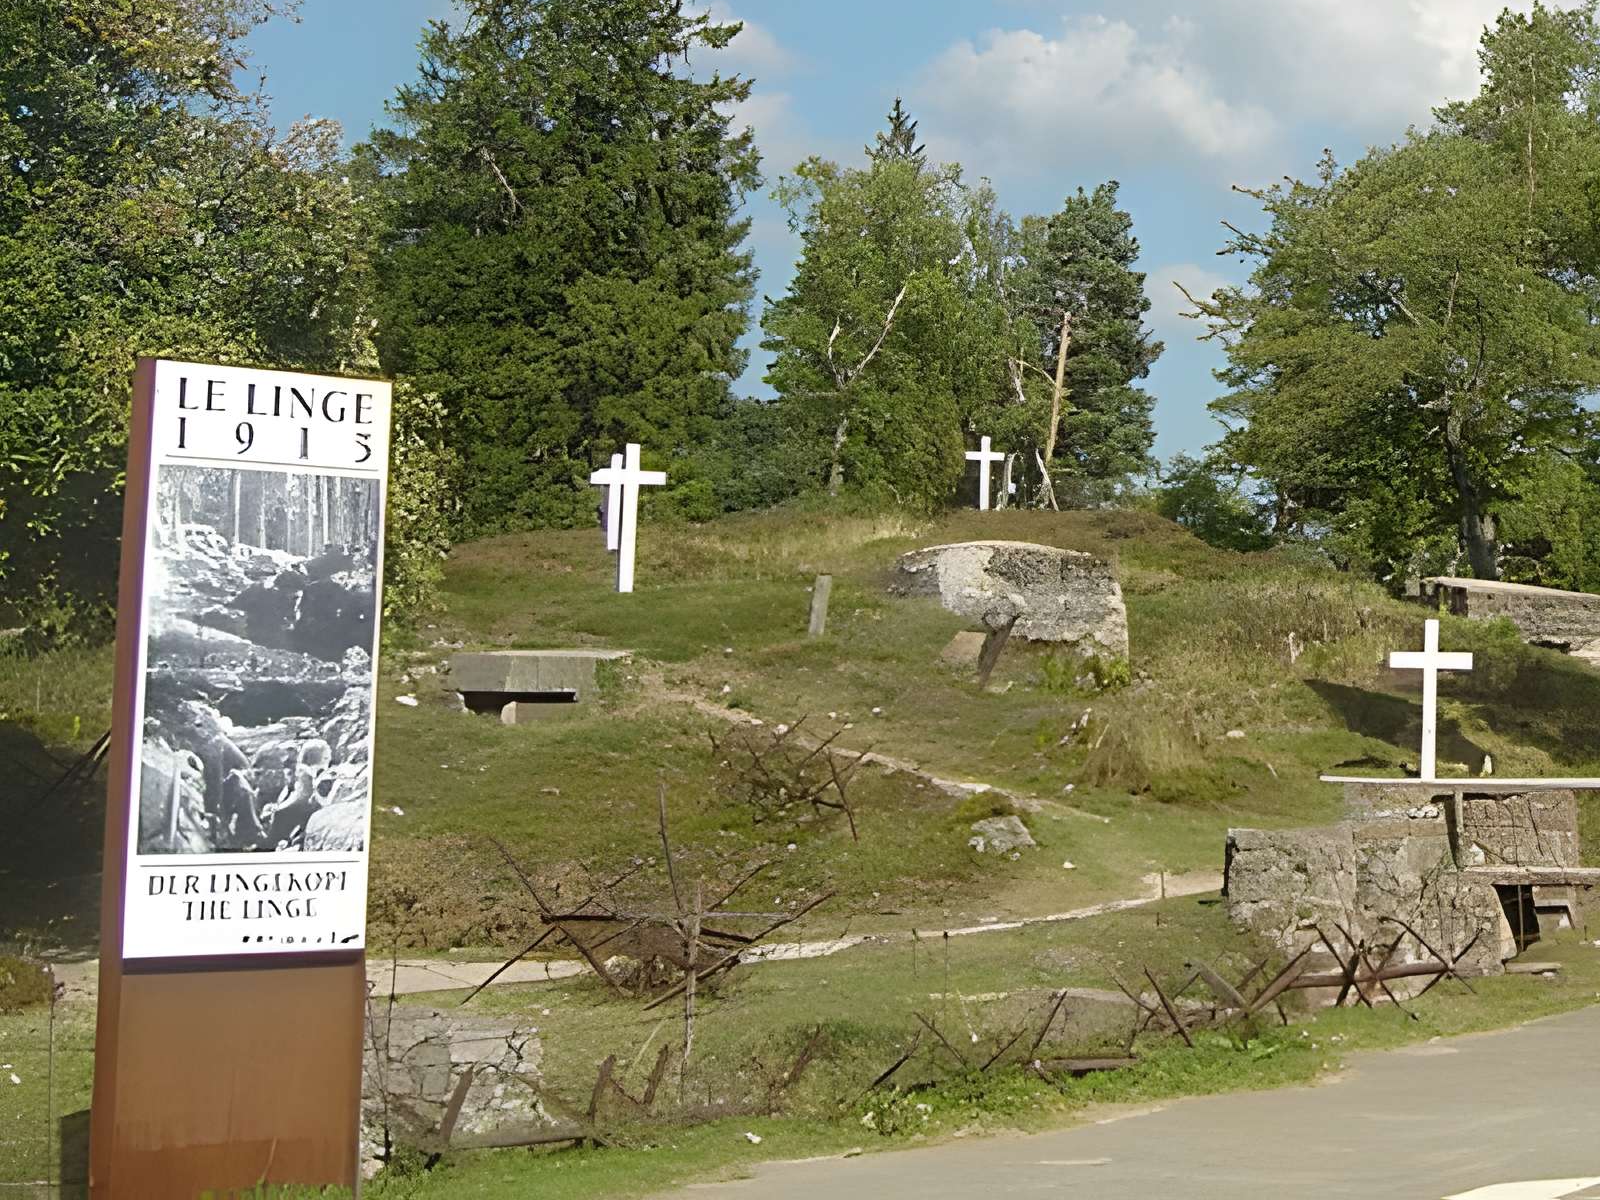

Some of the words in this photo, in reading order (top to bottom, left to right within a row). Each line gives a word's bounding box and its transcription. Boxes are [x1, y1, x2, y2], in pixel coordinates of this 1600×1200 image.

[178, 377, 226, 412] LE
[247, 383, 373, 424] LINGE
[178, 417, 372, 463] 1915
